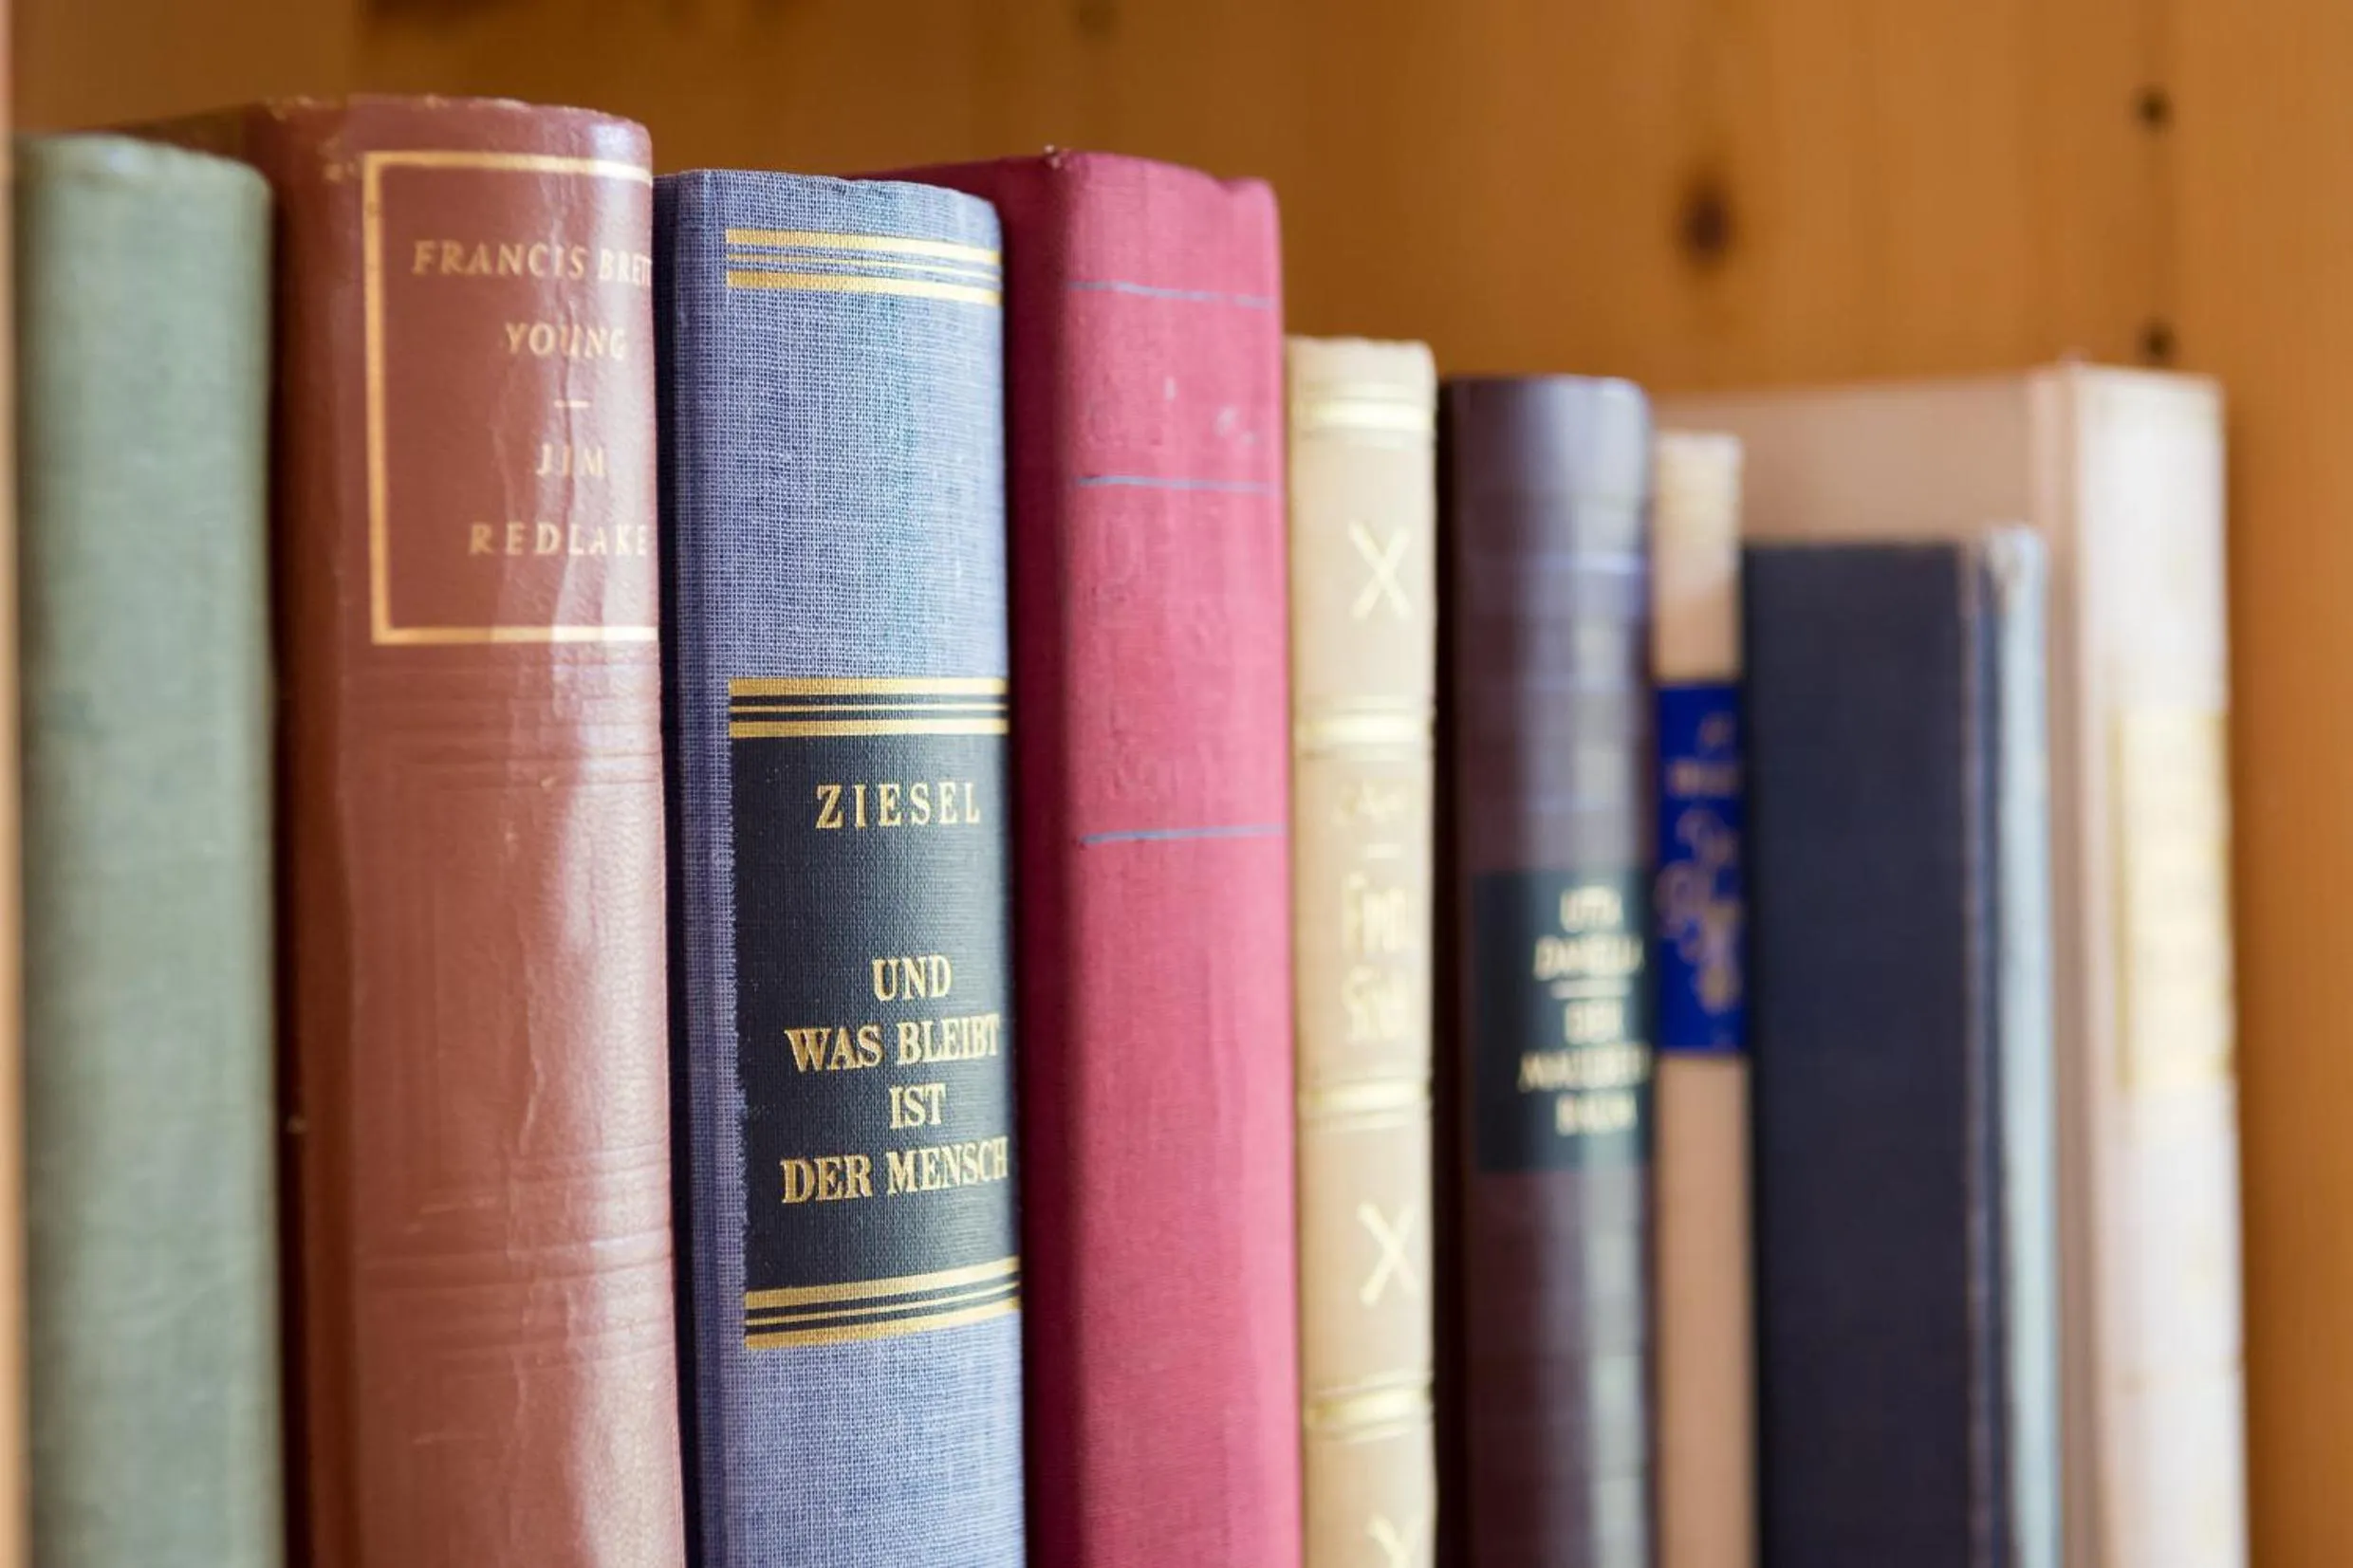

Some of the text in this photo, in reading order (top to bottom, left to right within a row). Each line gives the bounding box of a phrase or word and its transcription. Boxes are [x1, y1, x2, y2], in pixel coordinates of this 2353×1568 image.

[411, 240, 586, 280] FRANCIS
[504, 322, 626, 361] YOUNG
[536, 443, 606, 476] JIM
[469, 522, 648, 556] REDLAKE
[816, 781, 980, 829] ZIESEL
[872, 954, 952, 1002] UND
[784, 1013, 1001, 1073] WAS BLEIBT
[889, 1082, 946, 1130] IST
[779, 1136, 1010, 1205] DER MENSCH
